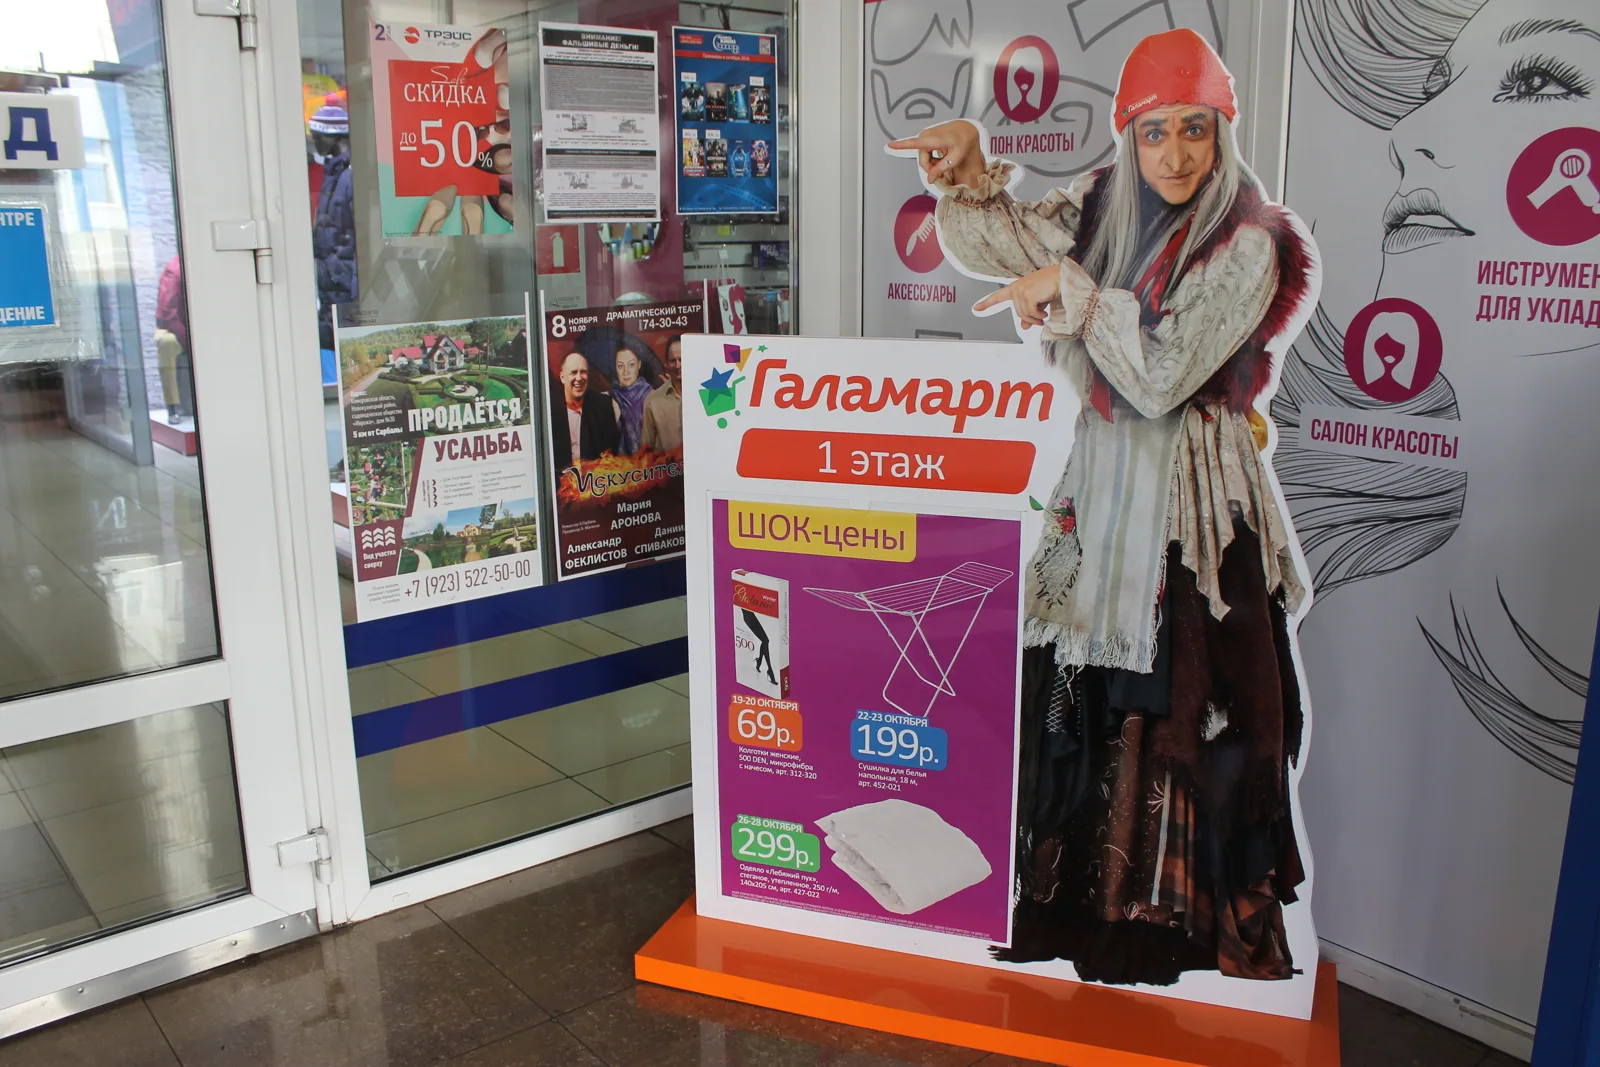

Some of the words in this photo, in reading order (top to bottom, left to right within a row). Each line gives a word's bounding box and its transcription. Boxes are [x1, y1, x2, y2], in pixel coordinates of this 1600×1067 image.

[375, 24, 386, 40] 2
[581, 33, 622, 42] ВНИМАНИЕ!
[562, 40, 610, 48] ФАЛЬШИВЫЕ
[610, 42, 639, 50] ДЕНЬГИ!
[404, 82, 488, 107] СКИДКА
[1128, 94, 1158, 112] Галамарт
[1016, 132, 1074, 153] КРАСОТЫ
[887, 283, 956, 303] АКСЕССУАРЫ
[606, 306, 677, 322] ДРАМАТИЧЕСКИЙ
[678, 305, 701, 314] ТЕАТР
[1476, 294, 1520, 322] ДЛЯ
[1527, 298, 1600, 328] УКЛАД
[552, 315, 567, 338] 8
[568, 316, 598, 325] НОЯБРЯ
[643, 316, 688, 330] 74-30-43
[749, 358, 1054, 434] Галамарт
[408, 395, 521, 432] ПРОДАЁТСЯ
[433, 431, 522, 463] УСАДЬБА
[1310, 418, 1368, 447] САЛОН
[1372, 426, 1459, 459] КРАСОТЫ
[818, 440, 837, 473] 1
[851, 450, 945, 480] этаж
[617, 500, 652, 514] Мария
[610, 512, 662, 530] АРОНОВА
[654, 524, 686, 539] Дании
[738, 511, 904, 551] ШОК-цены
[567, 536, 622, 554] Александр
[635, 537, 685, 555] СПИВАКОВ
[375, 550, 396, 559] участка
[565, 548, 628, 570] ФЕКЛИСТОВ
[364, 561, 383, 569] сверху
[404, 579, 420, 598] +7
[425, 571, 460, 597] (923)
[465, 559, 530, 587] 522-50-00
[736, 636, 755, 652] 500
[733, 696, 756, 706] 19-20
[758, 698, 798, 711] ОКТЯБРЯ
[737, 708, 795, 747] 69р.
[858, 711, 885, 723] 22-23
[886, 714, 927, 727] ОКТЯБРЯ
[738, 746, 769, 756] Колготки
[770, 751, 801, 762] женские,
[857, 724, 938, 766] 199р.
[739, 754, 752, 762] 500
[753, 756, 768, 765] DEN,
[770, 760, 814, 771] микрофибра
[858, 762, 889, 773] Сушилка
[905, 768, 927, 778] белья
[744, 764, 774, 774] начесом,
[776, 768, 789, 776] арт.
[790, 770, 817, 780] 312-320
[858, 772, 898, 783] напольная,
[900, 776, 909, 784] 18
[858, 780, 871, 788] арт.
[873, 781, 901, 791] 452-021
[738, 815, 761, 826] 26-28
[762, 820, 802, 833] ОКТЯБРЯ
[738, 827, 814, 868] 299р.
[740, 864, 765, 874] Одеяло
[766, 868, 800, 879] «Лебяжий
[801, 875, 818, 884] пух»,
[740, 873, 770, 882] стеганое,
[770, 877, 812, 890] утепленное,
[813, 883, 825, 891] 250
[826, 885, 840, 894] г/м,
[794, 888, 820, 898] 427-022
